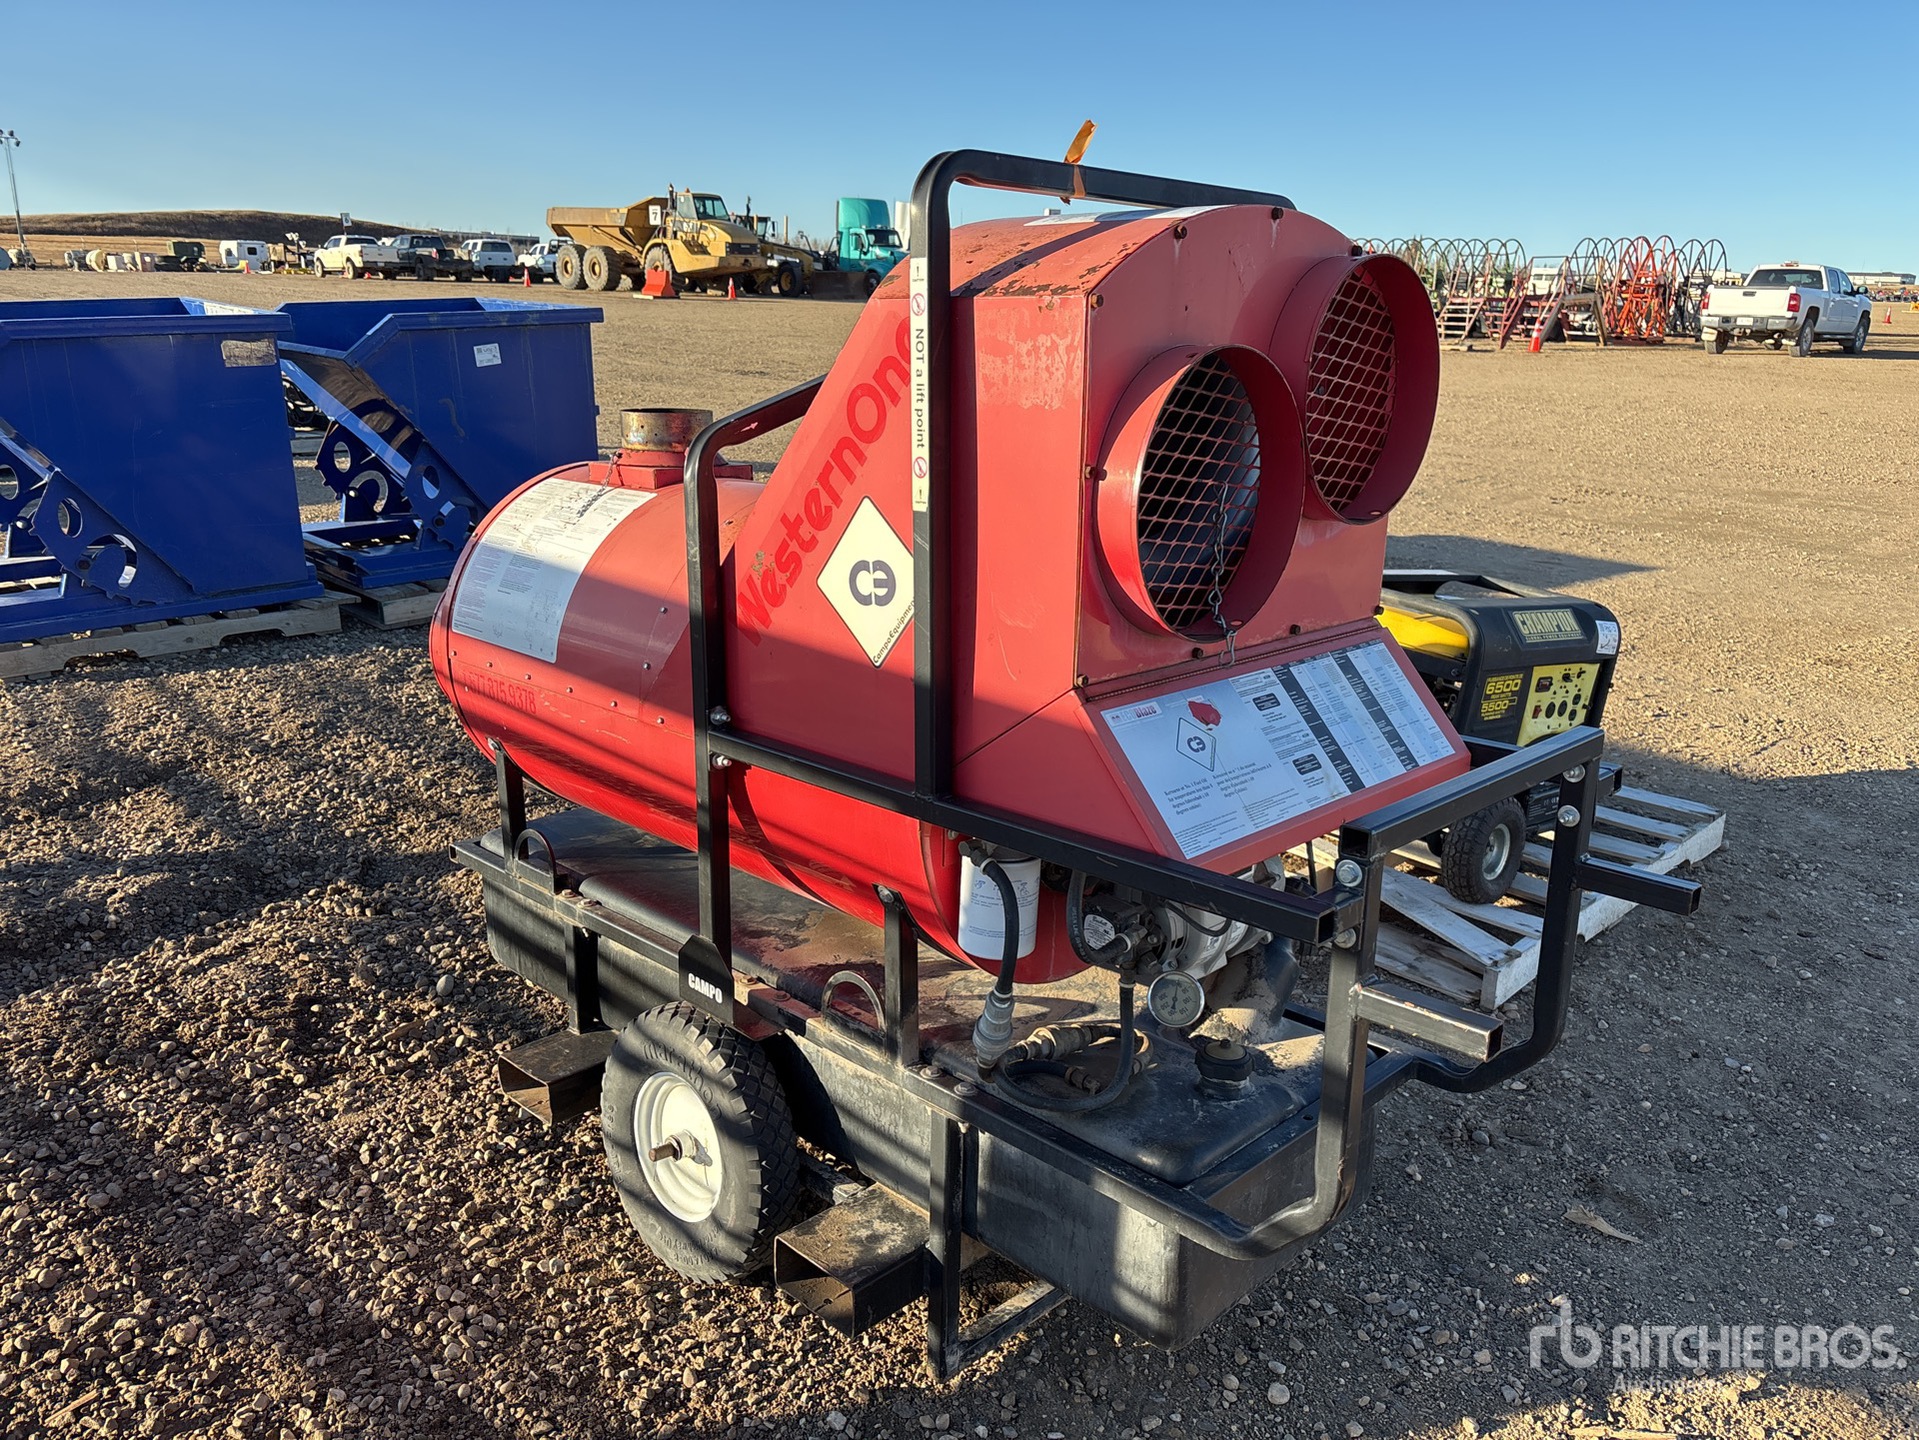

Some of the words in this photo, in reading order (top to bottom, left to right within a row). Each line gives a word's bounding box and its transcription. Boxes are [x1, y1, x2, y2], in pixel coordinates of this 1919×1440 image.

[652, 212, 658, 221] 7
[915, 328, 925, 364] NOT
[915, 368, 923, 378] a
[916, 383, 925, 403] lift
[914, 408, 925, 448] point
[872, 596, 915, 663] CampoEquipmen
[1514, 611, 1579, 634] CHAMPION
[1486, 679, 1521, 694] 6500
[1481, 700, 1509, 712] 5500
[688, 972, 723, 1004] CAMPO
